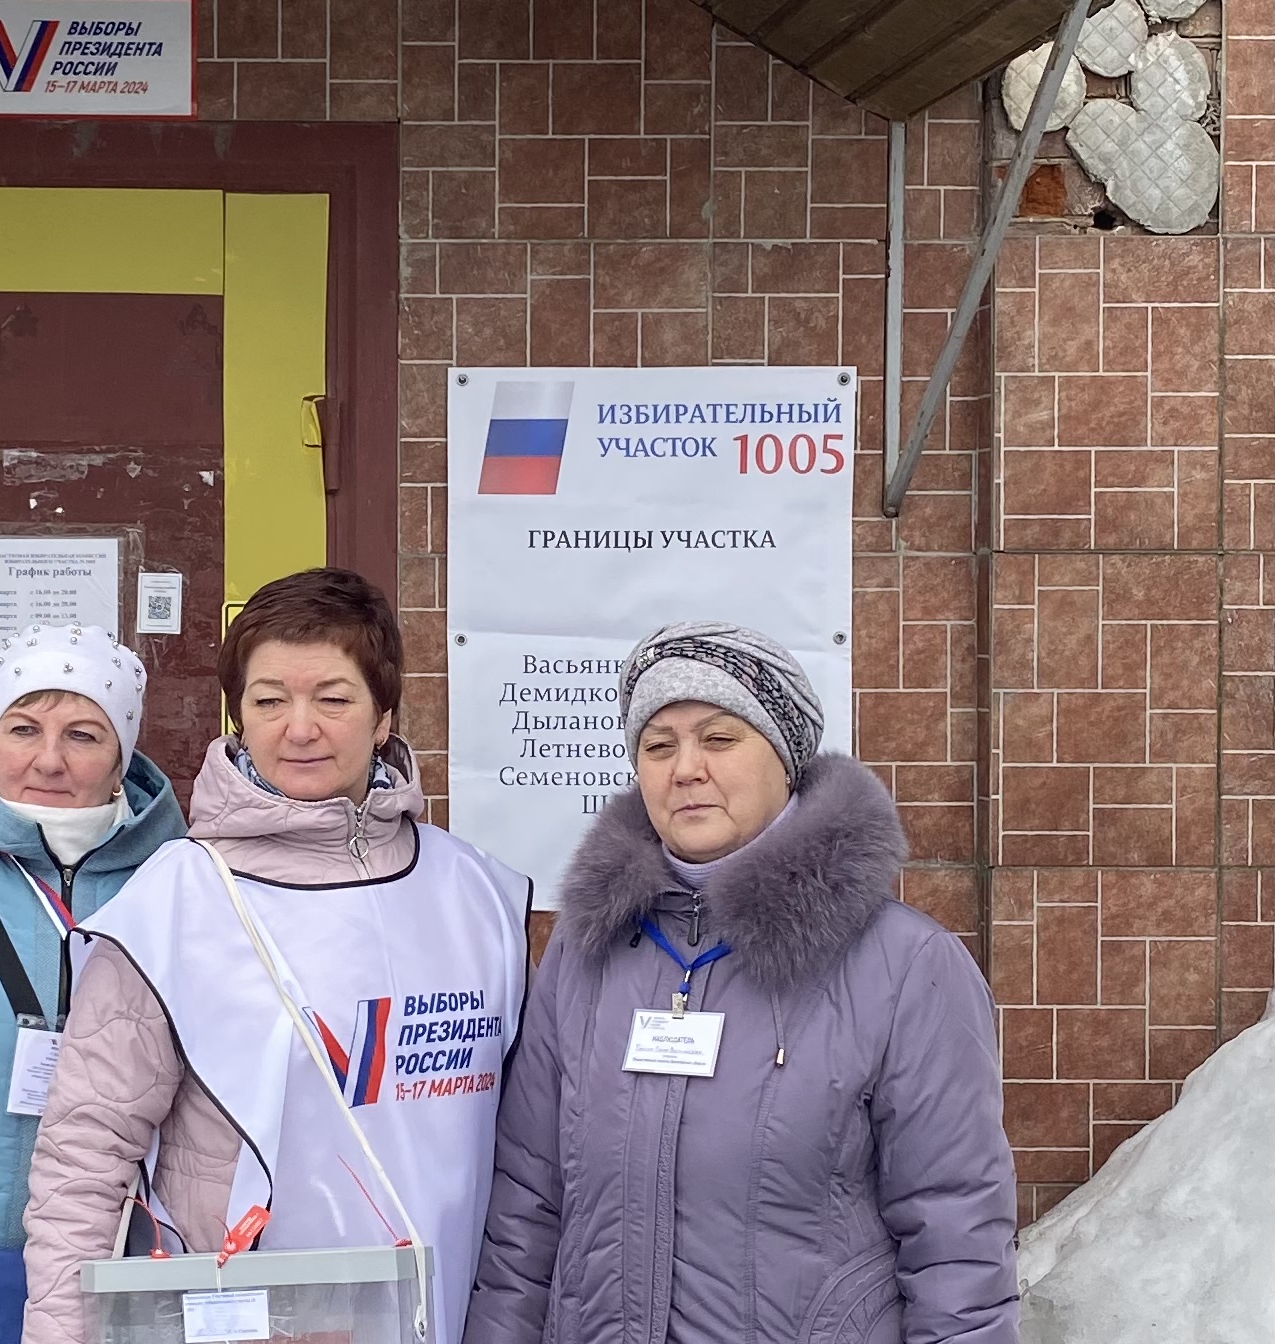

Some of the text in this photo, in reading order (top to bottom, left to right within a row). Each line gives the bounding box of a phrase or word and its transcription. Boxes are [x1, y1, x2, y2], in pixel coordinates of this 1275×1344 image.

[66, 21, 143, 36] ВЫБОРЫ
[58, 41, 164, 58] ПРЕЗИДЕНТА
[50, 61, 119, 76] РОССИИ
[78, 81, 118, 94] МАРТА
[120, 81, 149, 94] 2024
[596, 397, 842, 425] ИЗБИРАТЕЛЬНЫЙ
[596, 433, 846, 475] УЧАСТОК 1005
[527, 529, 777, 553] ГРАНИЦЫ УЧАСТКА
[8, 566, 92, 578] График работы
[523, 654, 625, 674] Васьянк
[499, 682, 618, 706] Демидко
[512, 710, 626, 734] Дылано
[520, 738, 626, 758] Летнево
[499, 766, 638, 786] Семеновск
[403, 989, 485, 1017] ВЫБОРЫ
[397, 1015, 503, 1046] ПРЕЗИДЕНТА
[395, 1047, 474, 1075] РОССИИ
[427, 1074, 475, 1098] МАРТА
[475, 1072, 496, 1093] 2024
